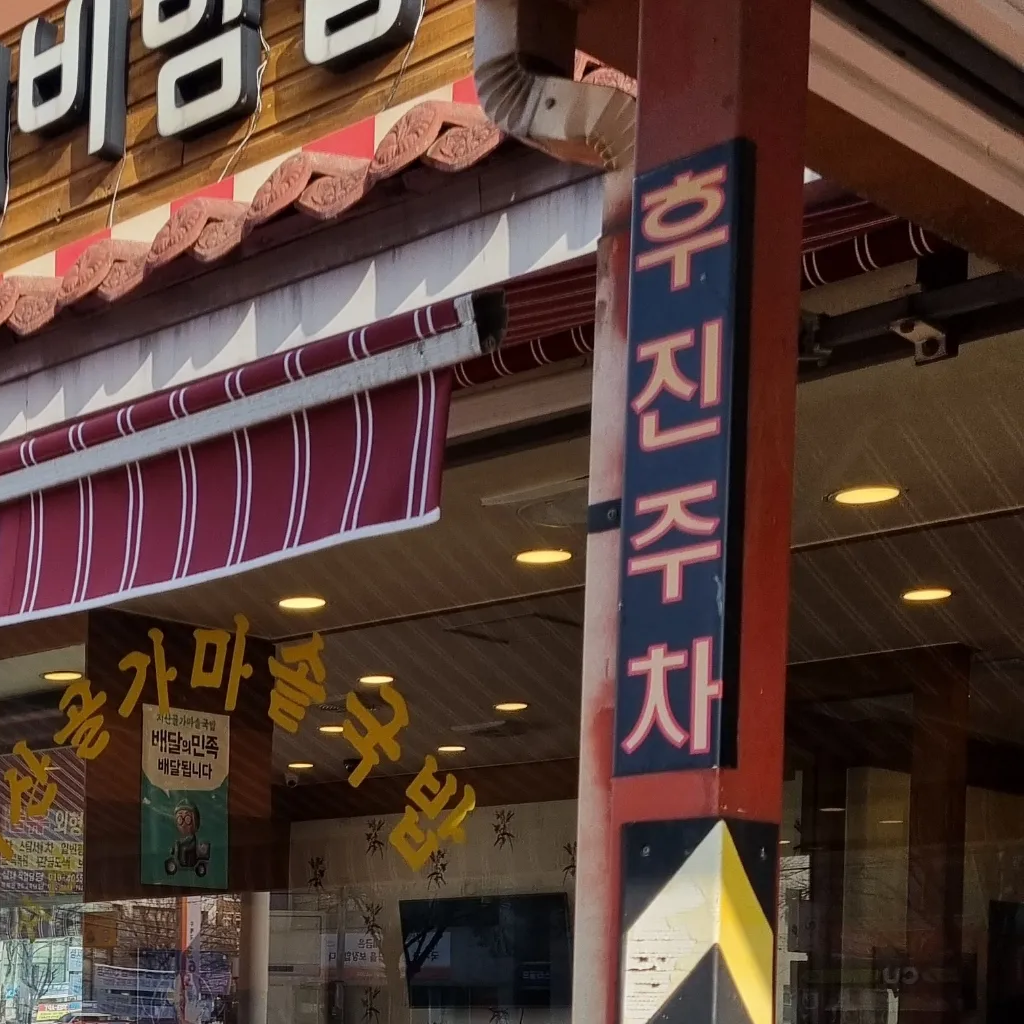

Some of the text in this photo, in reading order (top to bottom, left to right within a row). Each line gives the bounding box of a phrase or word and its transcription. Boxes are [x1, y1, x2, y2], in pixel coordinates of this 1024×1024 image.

[622, 164, 729, 756] 후진주차
[151, 729, 219, 759] 배달의민족
[158, 758, 213, 780] 배달됩니다
